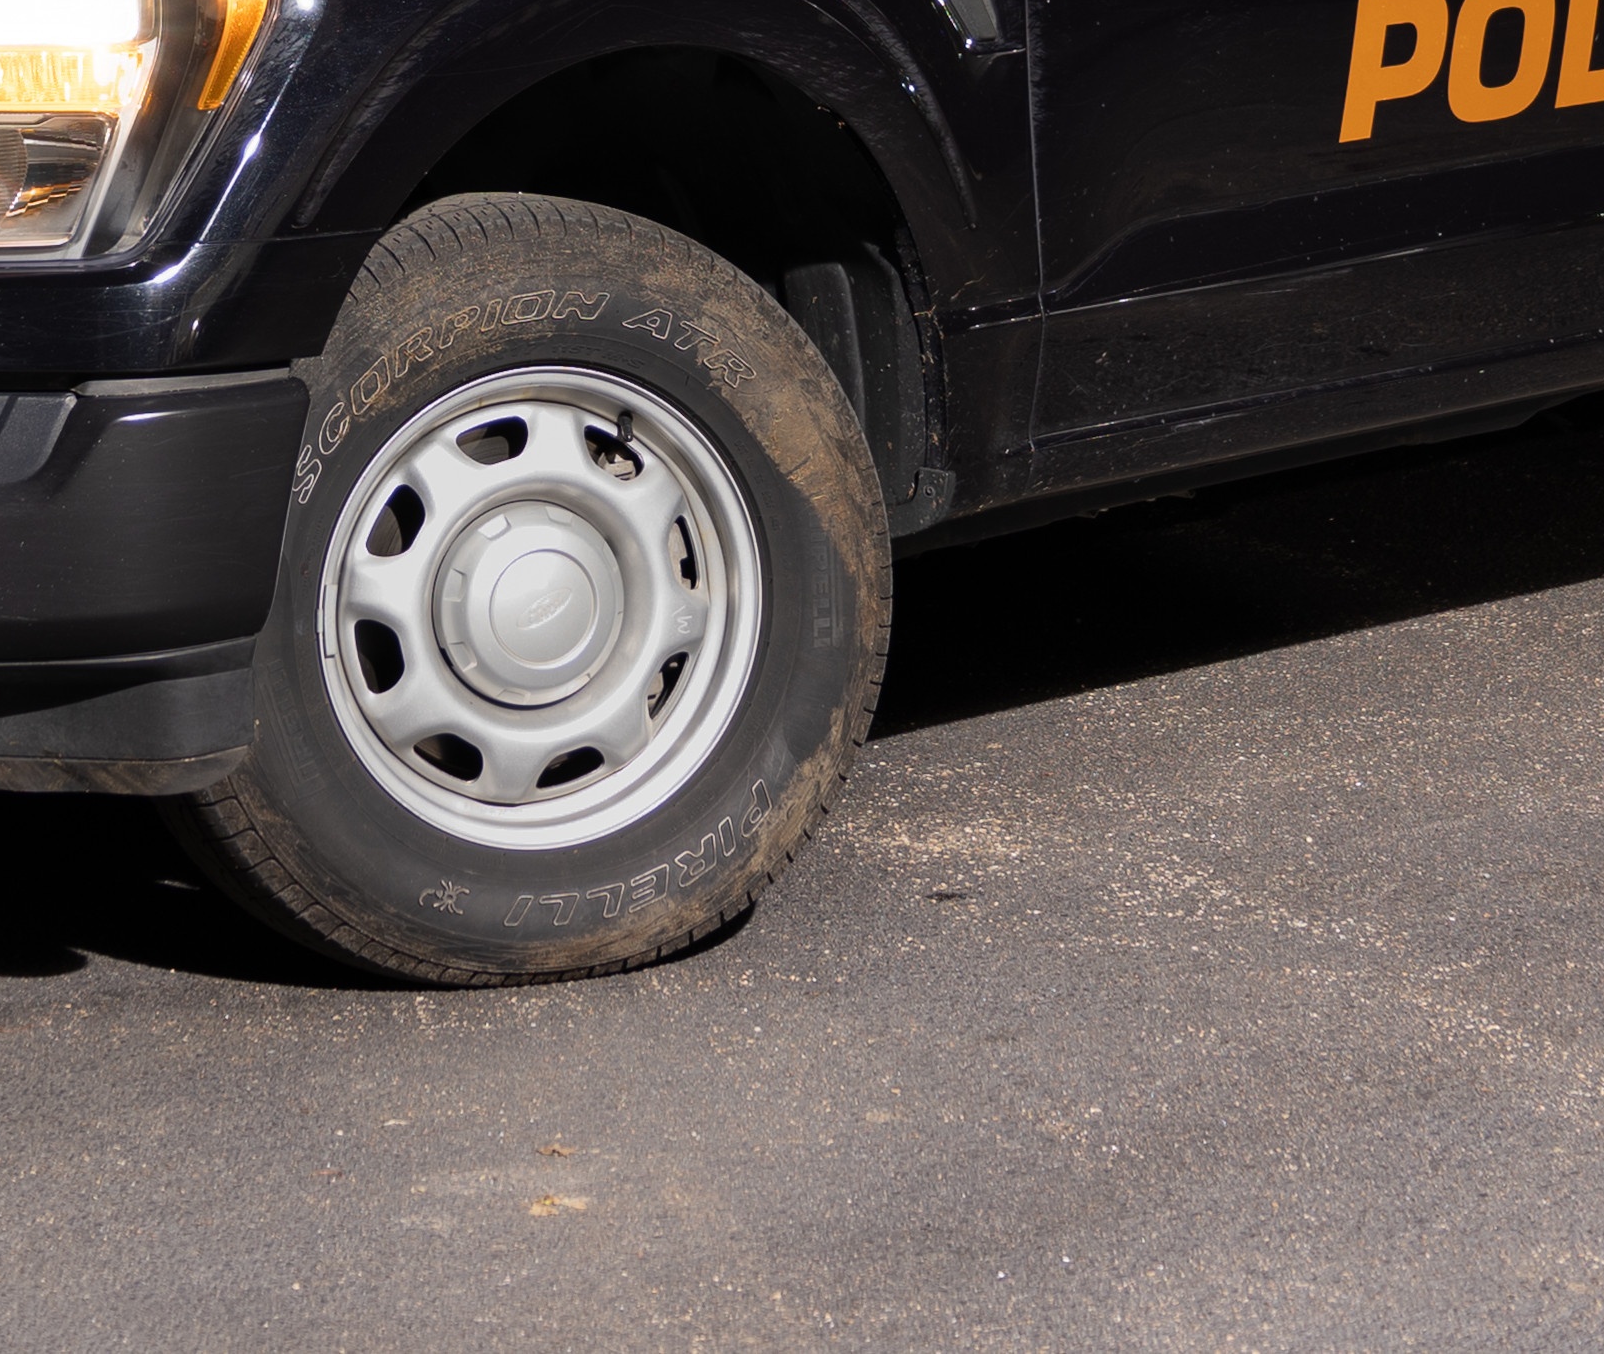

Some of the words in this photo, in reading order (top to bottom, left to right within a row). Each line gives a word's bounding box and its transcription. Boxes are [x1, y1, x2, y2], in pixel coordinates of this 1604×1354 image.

[292, 289, 609, 504] SCORPION
[622, 308, 757, 389] ATR
[504, 779, 773, 927] PIRELLI
